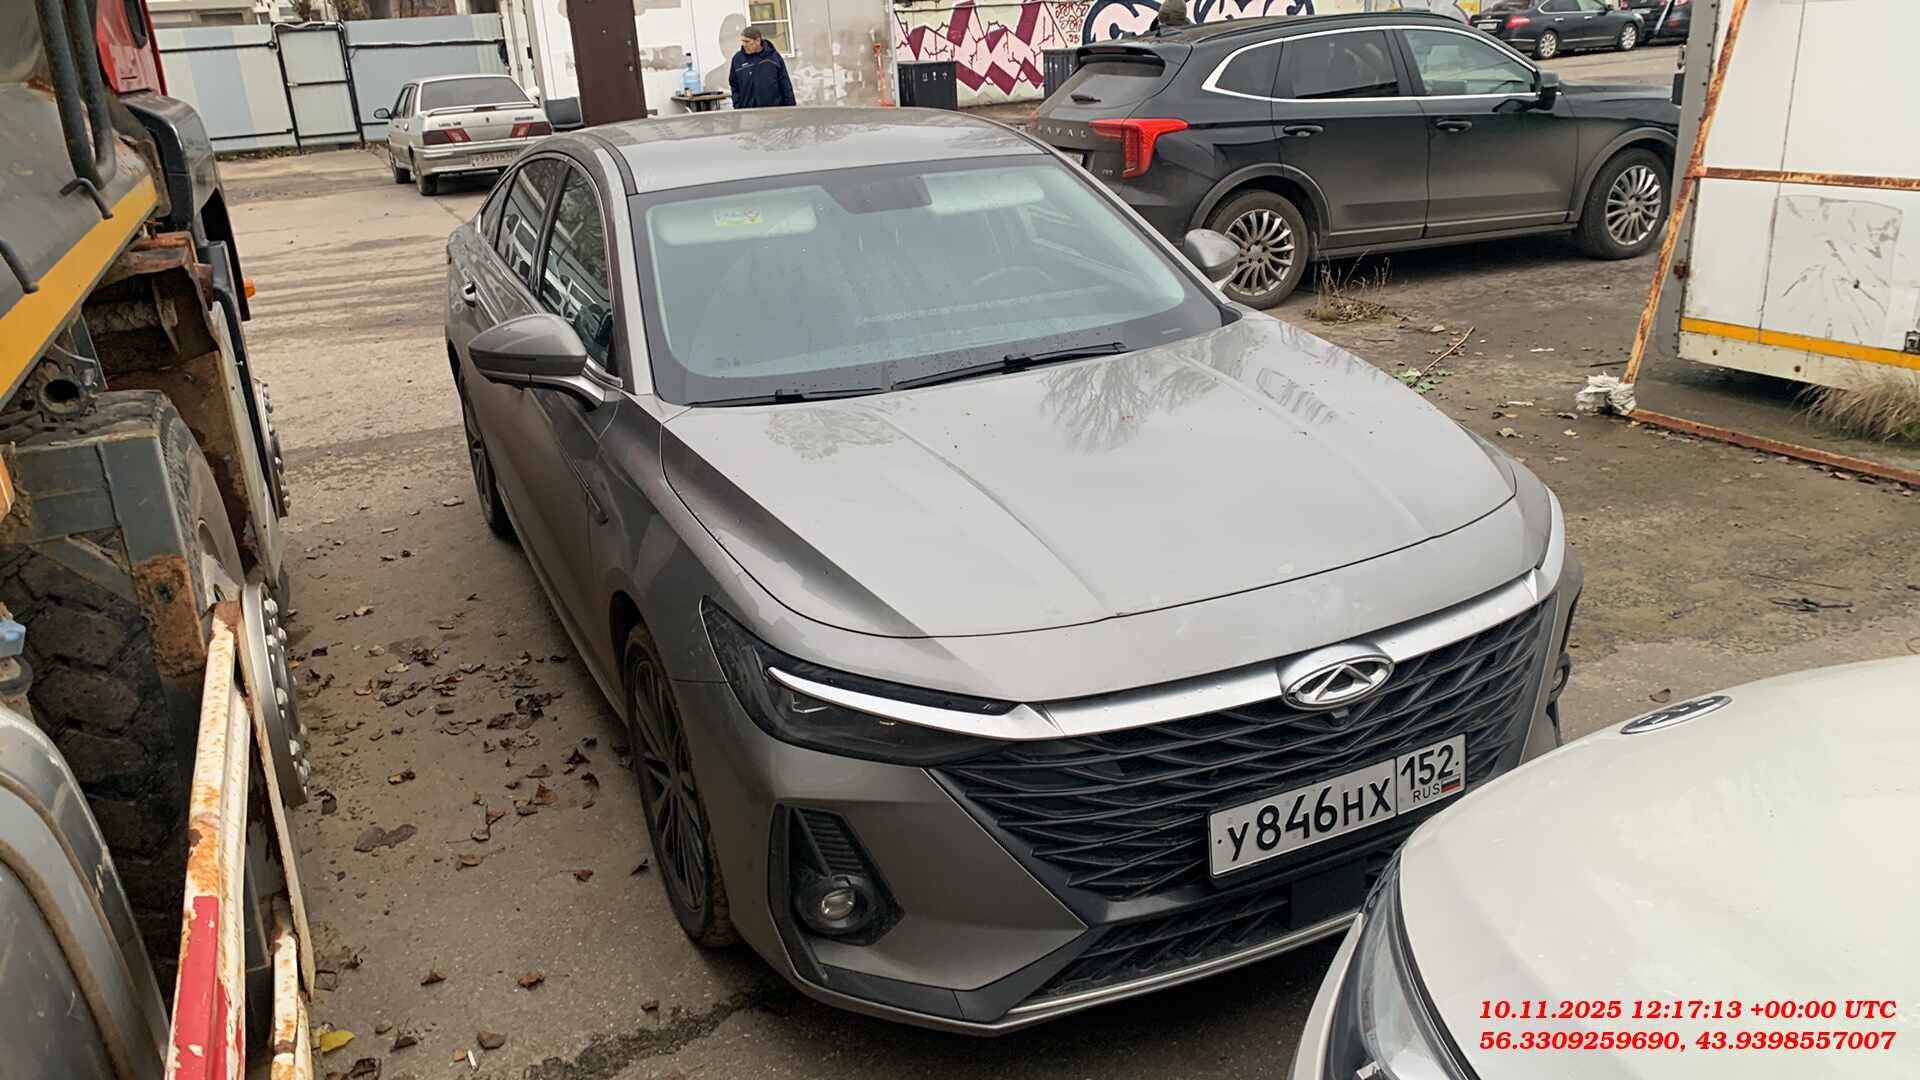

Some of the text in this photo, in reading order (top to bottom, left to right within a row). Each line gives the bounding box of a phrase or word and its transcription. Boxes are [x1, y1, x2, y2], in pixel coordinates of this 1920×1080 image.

[1227, 744, 1455, 861] У846НХ 152
[1412, 782, 1441, 804] RUS
